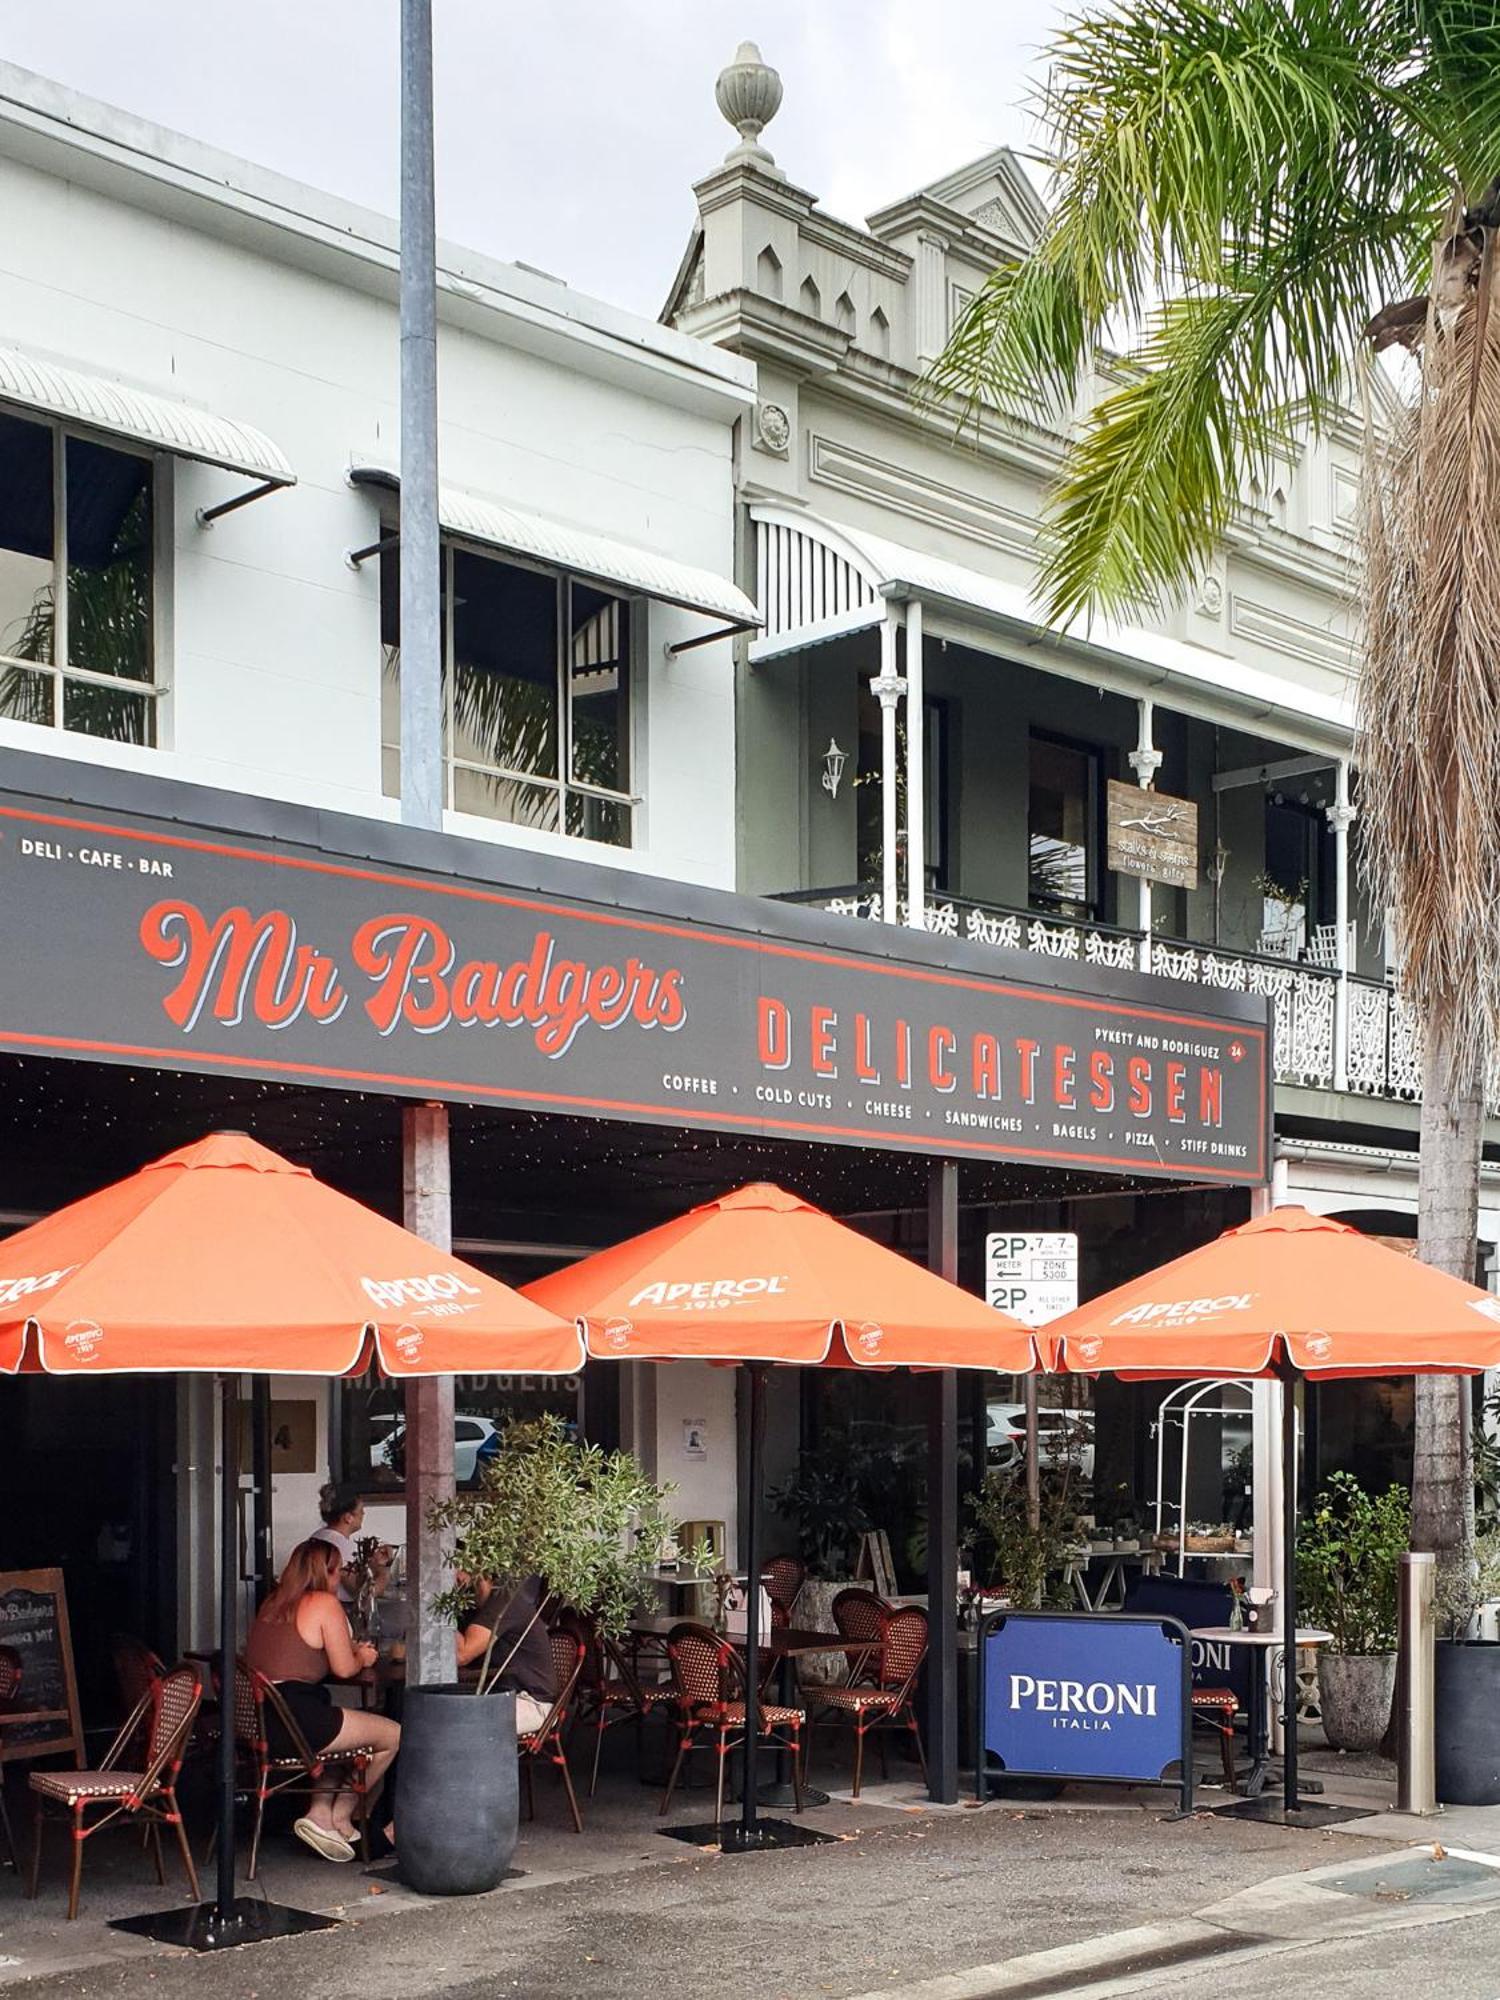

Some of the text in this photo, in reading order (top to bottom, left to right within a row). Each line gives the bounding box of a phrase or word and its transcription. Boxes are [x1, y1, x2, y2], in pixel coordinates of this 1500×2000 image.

[22, 839, 173, 877] DELI CAFE BAR
[140, 900, 688, 1060] Mr Badgers
[1095, 1028, 1220, 1059] PYKETT AND RODRIGUEZ
[1231, 1046, 1242, 1057] 24
[757, 996, 1223, 1128] DELICATESSEN
[663, 1074, 1247, 1158] COFFEE COLD CUTS CHEESE SANDWICHES BAGELS PIZZA STIFF DRINKS
[992, 1238, 1027, 1259] 2P
[996, 1260, 1023, 1269] METER
[1043, 1261, 1067, 1270] ZONE
[360, 1271, 482, 1309] APEROL
[628, 1275, 788, 1307] APEROL
[682, 1299, 732, 1311] 1919
[992, 1288, 1027, 1309] 2P
[1108, 1293, 1255, 1326] APEROL
[1009, 1674, 1157, 1717] PERONI
[1053, 1717, 1112, 1731] ITALIA
